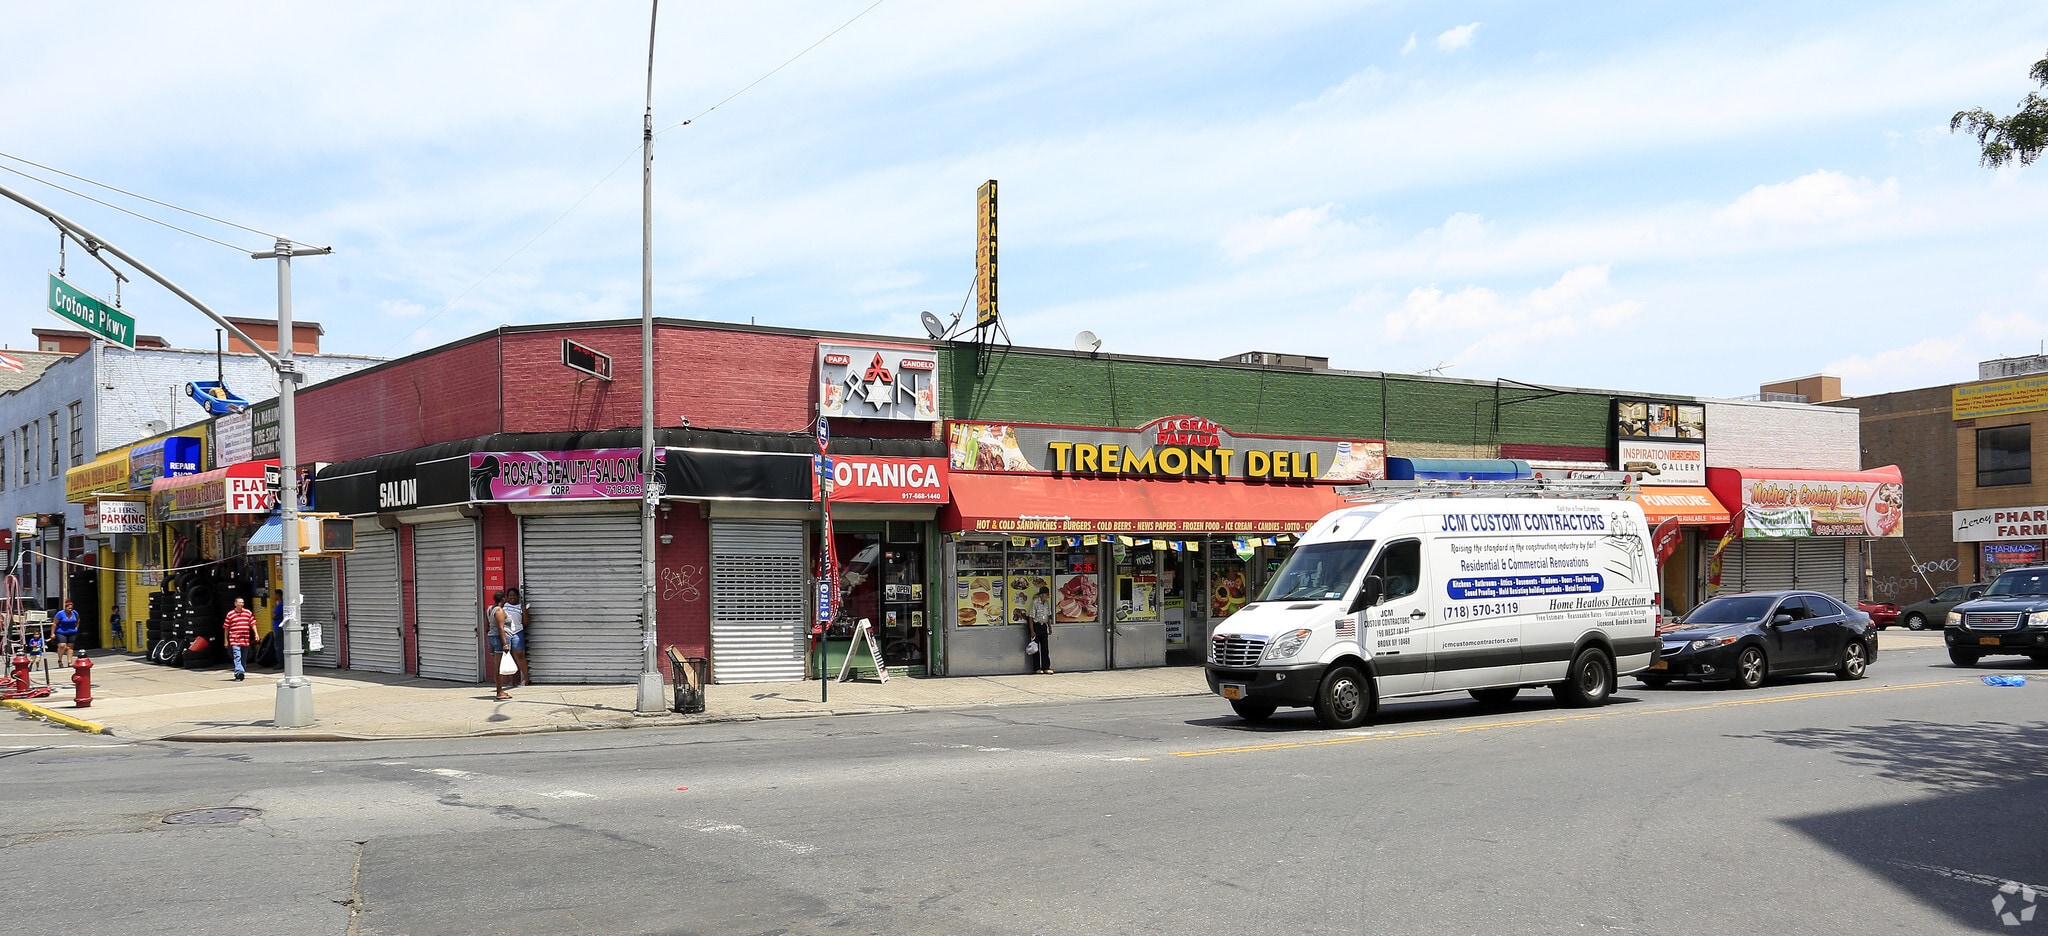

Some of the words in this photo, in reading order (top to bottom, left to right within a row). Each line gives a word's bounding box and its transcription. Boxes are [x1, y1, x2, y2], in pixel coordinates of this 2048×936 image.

[979, 201, 988, 259] FLAT
[980, 262, 988, 305] FIX
[55, 286, 95, 324] Crotona
[98, 309, 127, 343] Pkwy
[828, 355, 849, 364] PAPÁ
[902, 360, 934, 369] CANDELO
[1158, 420, 1176, 433] LA
[1179, 419, 1219, 435] GRAN
[1157, 433, 1221, 447] PARADA
[1048, 442, 1235, 476] TREMONT
[1248, 450, 1318, 478] DELI
[1624, 448, 1669, 460] INSPIRATION
[1670, 450, 1700, 460] DESIGNS
[169, 462, 196, 471] REPAIR
[503, 460, 543, 486] ROSA'S
[546, 459, 592, 484] BEAUTY
[595, 458, 636, 484] SALON
[1662, 462, 1700, 472] GALLERY
[233, 480, 266, 491] FLAT
[551, 486, 571, 495] CORP.
[380, 478, 417, 508] SALON
[1751, 483, 1797, 505] Mother's
[1800, 484, 1837, 511] Cooking
[1841, 485, 1867, 506] Pedro
[233, 494, 269, 509] FIX
[1641, 495, 1711, 507] FURNITURE
[119, 506, 139, 514] HRS.
[101, 514, 146, 524] PARKING
[976, 519, 990, 530] HOT
[992, 520, 998, 530] &
[999, 520, 1015, 530] COLD
[1016, 520, 1058, 531] SANDWICHES
[1062, 520, 1092, 531] BURGERS
[1097, 521, 1113, 531] COLD
[1113, 521, 1132, 531] BEERS
[1137, 521, 1154, 531] NEWS
[1155, 521, 1177, 531] PAPERS
[1183, 521, 1204, 531] FROZEN
[1205, 521, 1220, 531] FOOD
[1225, 521, 1233, 531] ICE
[1234, 521, 1253, 531] CREAM
[1258, 521, 1280, 531] CANDIES
[1284, 521, 1300, 531] LOTTO
[1442, 514, 1468, 532] JCM
[1471, 513, 1521, 532] CUSTOM
[1524, 513, 1605, 531] CONTRACTORS
[1958, 515, 1992, 531] Leroy
[1998, 524, 2047, 537] FARM
[1451, 543, 1472, 554] Raising
[1474, 543, 1482, 553] the
[1484, 543, 1508, 554] standard
[1509, 543, 1515, 553] in
[1516, 542, 1524, 553] the
[1526, 541, 1557, 553] construction
[1558, 541, 1579, 551] industry
[1580, 541, 1586, 550] by
[1985, 544, 2037, 553] PHARMACY
[1461, 559, 1500, 572] Residential
[1501, 558, 1507, 570] &
[1508, 558, 1549, 570] Commercial
[1550, 556, 1590, 569] Renovations
[1453, 580, 1472, 588] Kitchens
[1475, 579, 1497, 587] Bathrooms
[1500, 578, 1512, 586] Attics
[1583, 575, 1599, 583] Proofing
[1478, 588, 1496, 597] Proofing
[1510, 587, 1528, 595] Resisting
[1529, 586, 1545, 595] building
[1576, 584, 1592, 592] Framing
[1549, 599, 1573, 610] Home
[1576, 597, 1609, 608] Heatloss
[1611, 595, 1646, 607] Detection
[1380, 609, 1393, 617] JCM
[1443, 605, 1469, 620] (718)
[1473, 602, 1518, 616] 570-3119
[1546, 613, 1564, 621] Estimate
[1364, 620, 1381, 628] CUSTOM
[1382, 617, 1410, 626] CONTRACTORS
[1385, 628, 1395, 637] WEST
[1377, 640, 1391, 648] BRONX
[1442, 637, 1518, 649] jcmcustomcontractors.com
